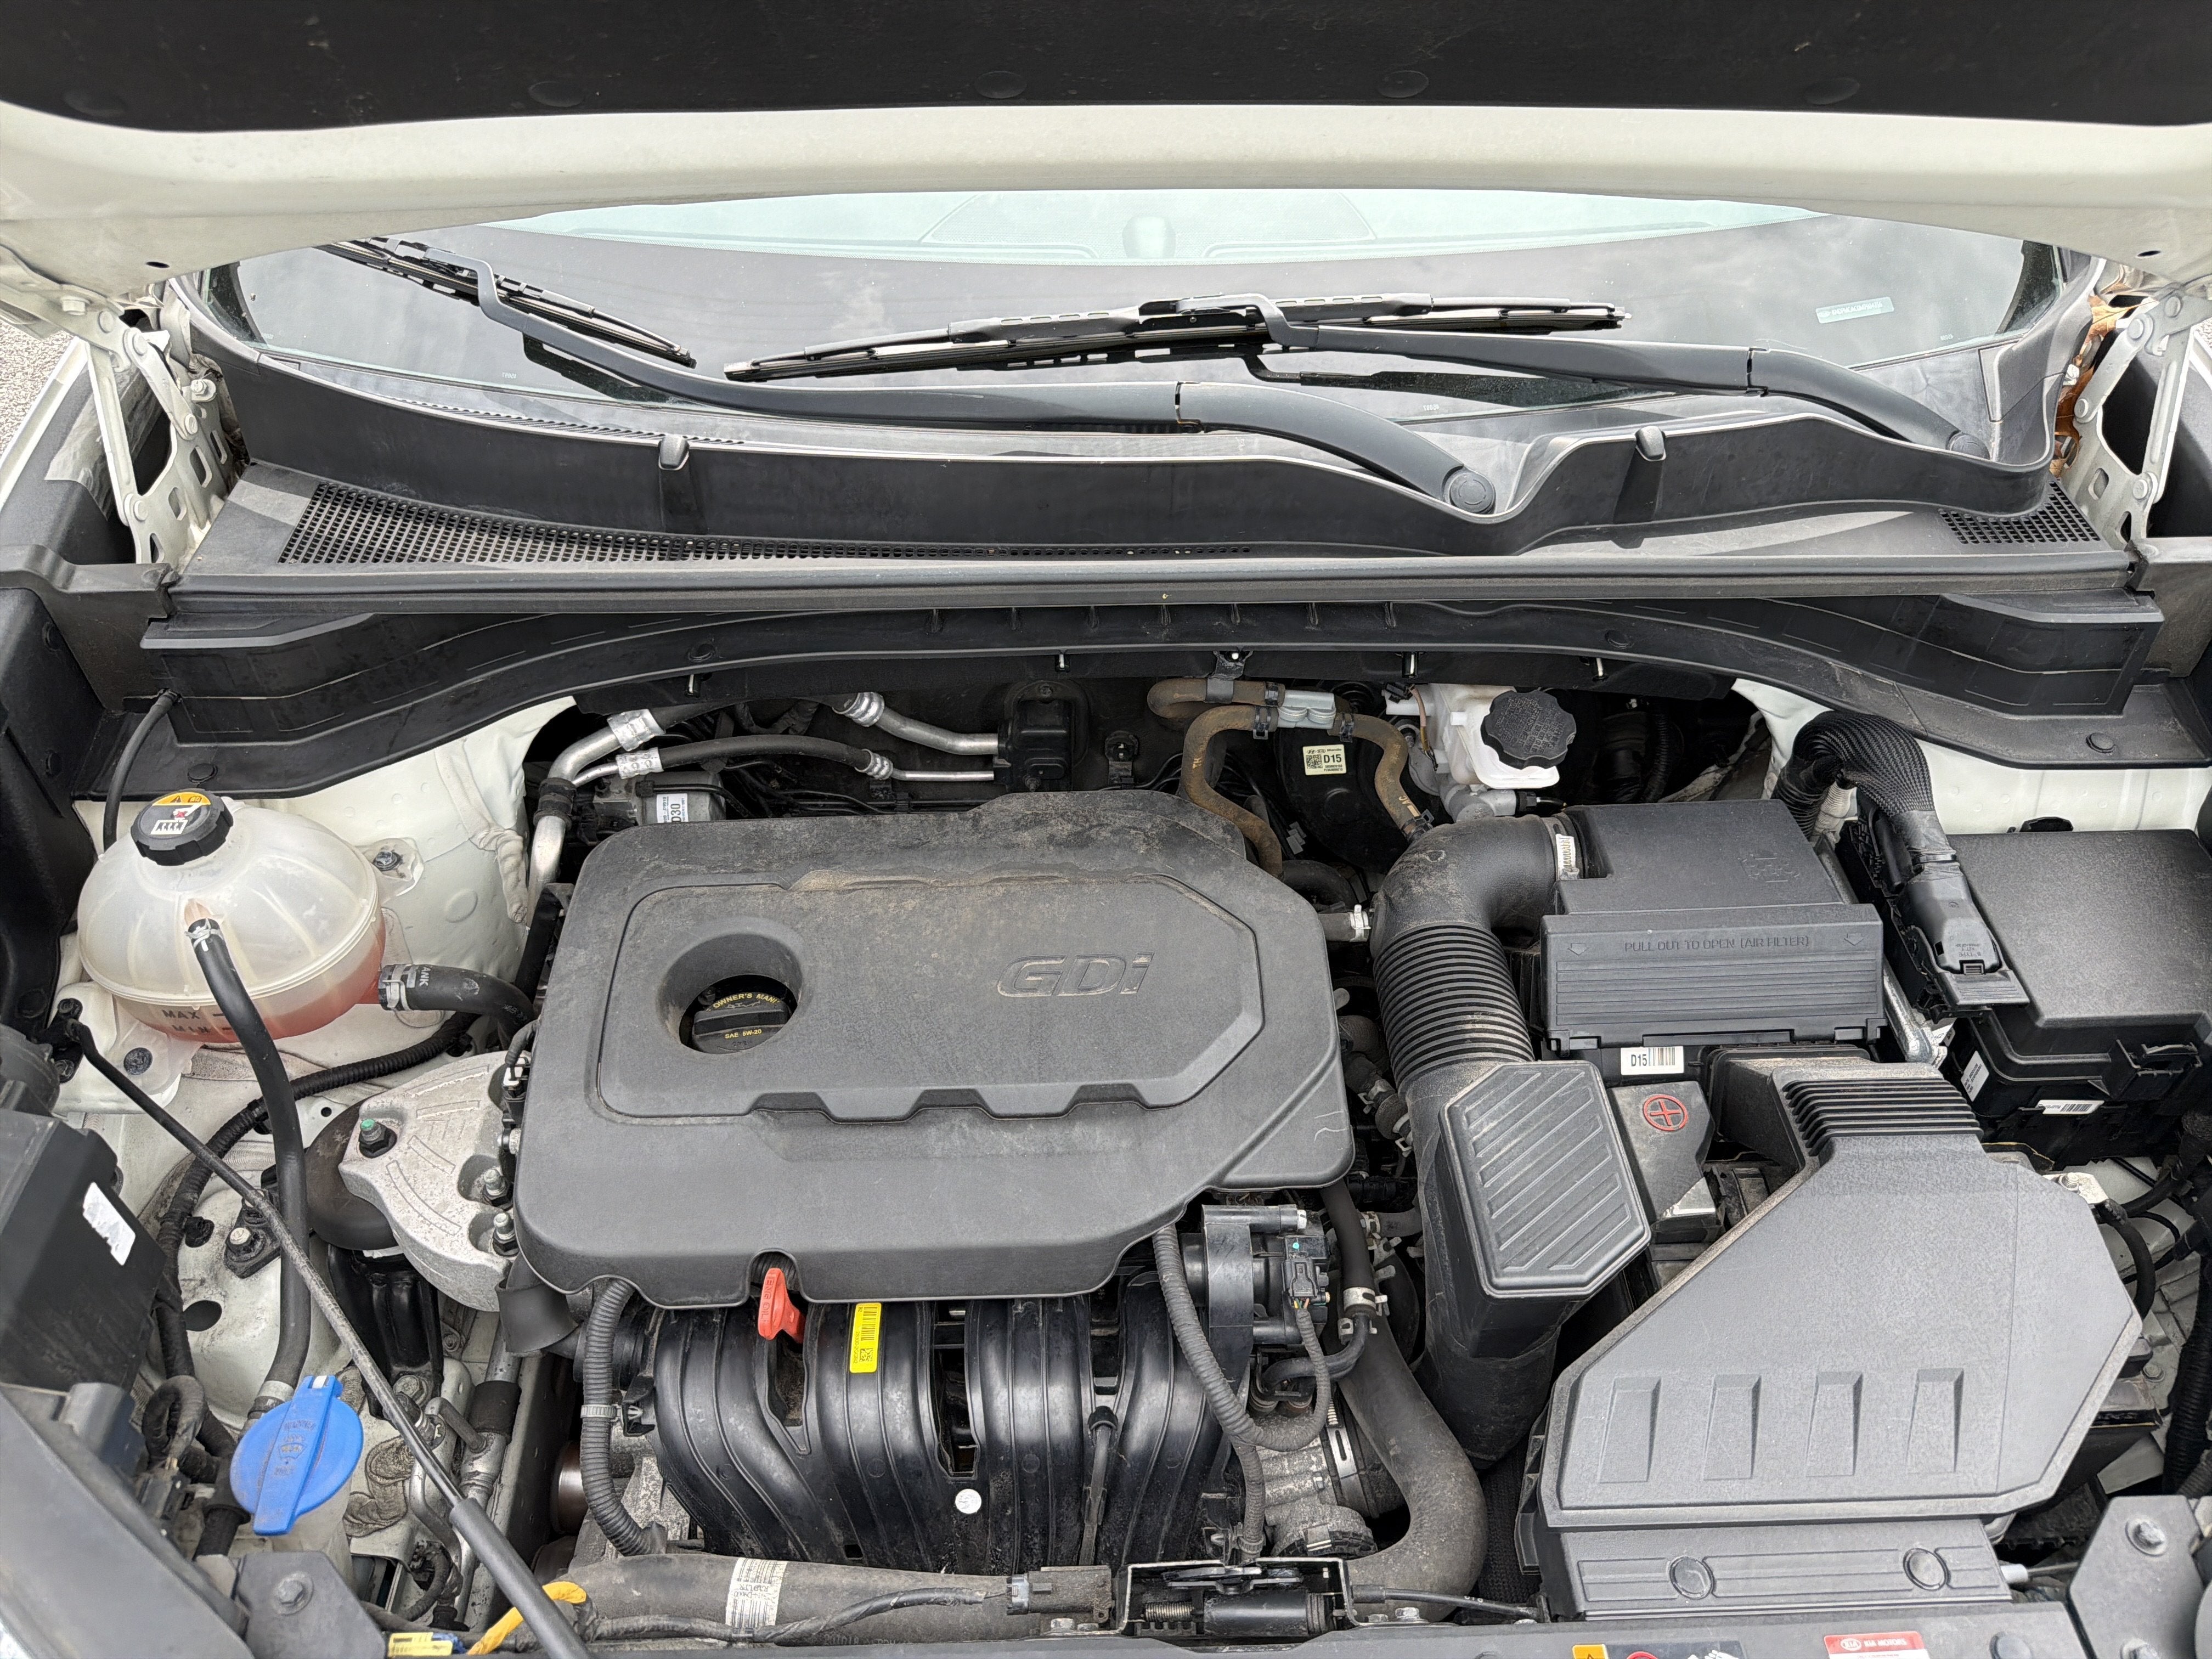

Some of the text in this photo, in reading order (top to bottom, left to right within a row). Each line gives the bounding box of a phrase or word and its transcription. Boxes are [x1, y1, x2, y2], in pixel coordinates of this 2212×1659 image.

[1323, 754, 1342, 763] D15
[1624, 941, 1652, 952] PULL
[1657, 941, 1679, 951] OUT
[1685, 940, 1700, 950] TO
[1703, 939, 1734, 949] OPEN
[713, 993, 753, 1008] OWNER'S
[162, 1009, 200, 1019] MAX
[172, 1024, 210, 1033] MIN
[1631, 1054, 1647, 1066] D15
[761, 1279, 774, 1319] ENG OIL
[1878, 1638, 1907, 1646] MOTORS
